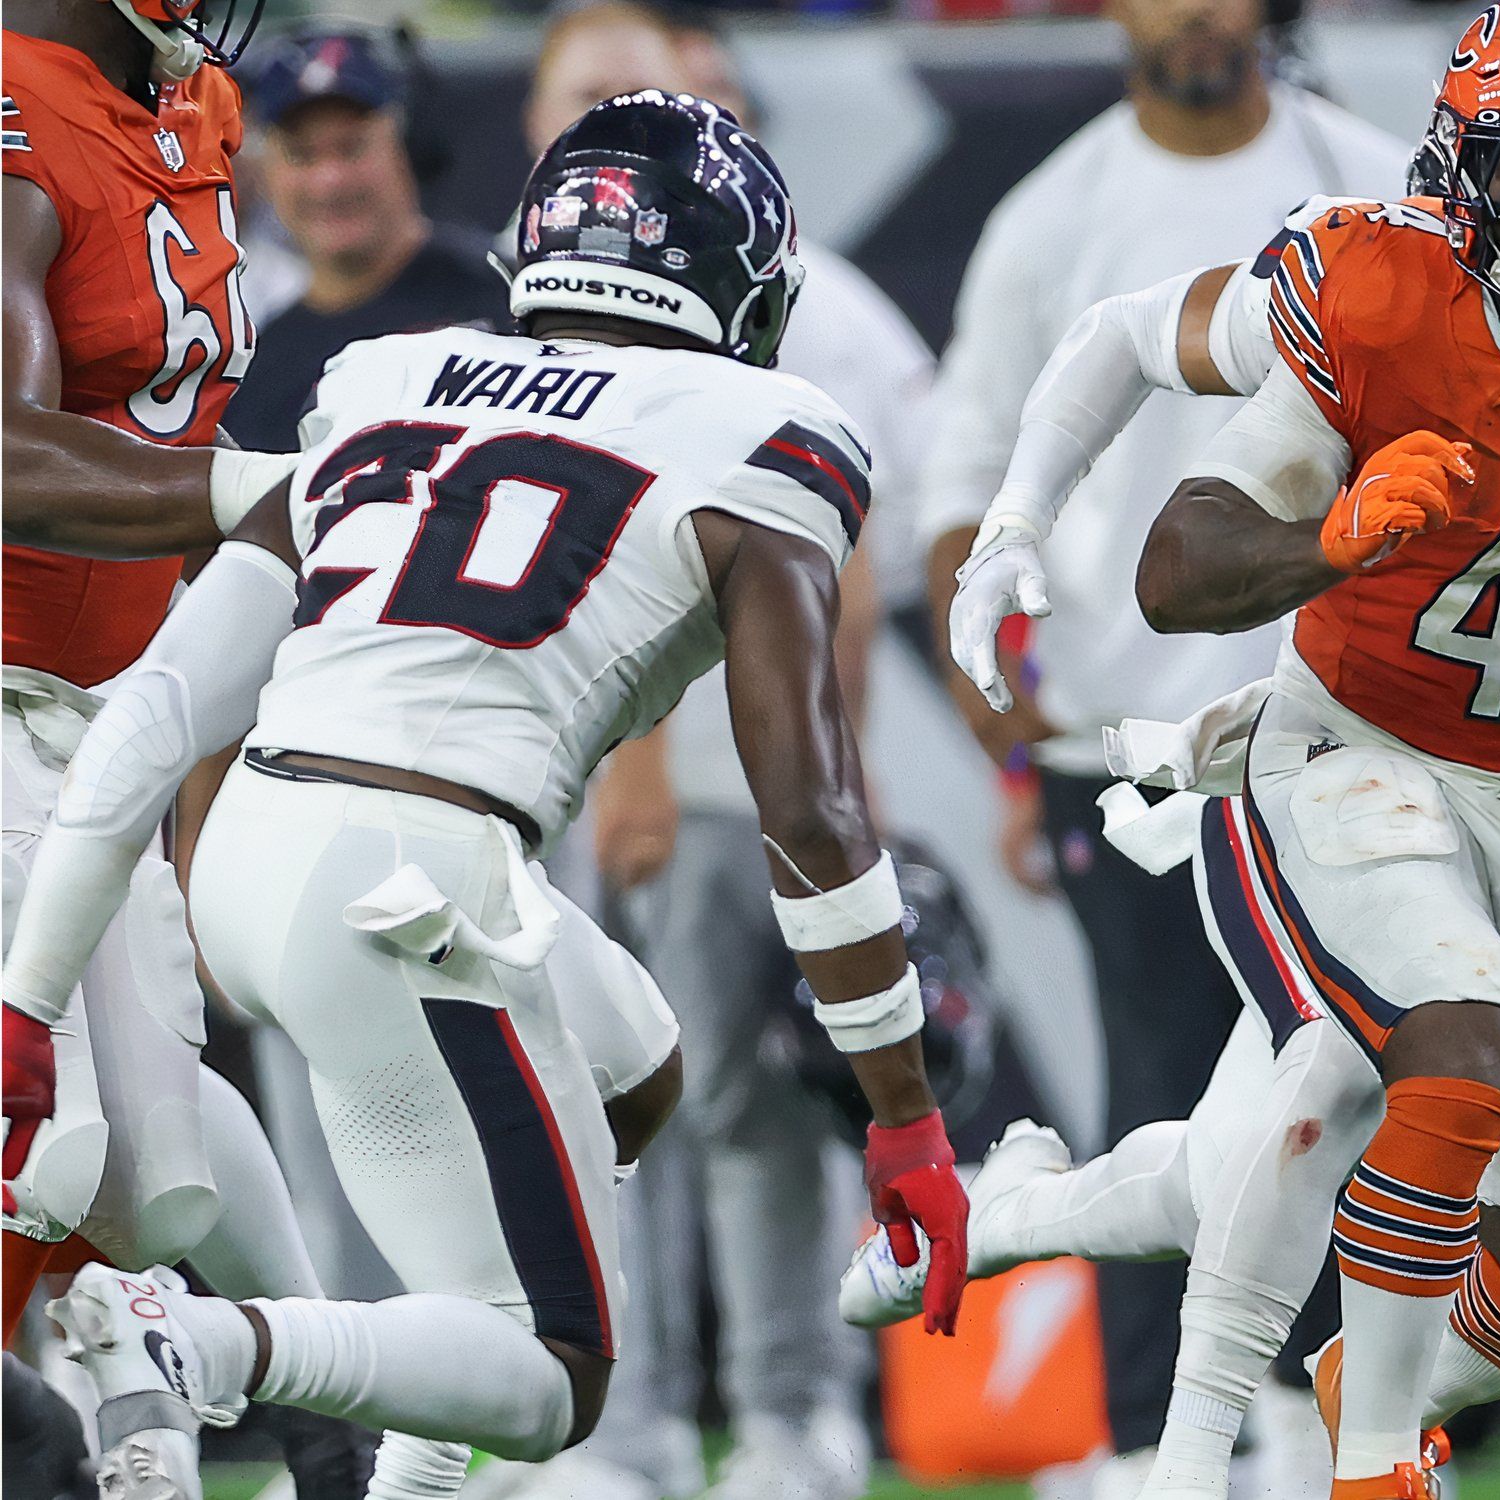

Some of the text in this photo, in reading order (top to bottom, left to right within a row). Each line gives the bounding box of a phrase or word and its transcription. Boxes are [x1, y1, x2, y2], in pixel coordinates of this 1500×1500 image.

[525, 278, 682, 314] HOUSTON
[423, 354, 616, 421] WARD
[293, 419, 659, 650] 20
[115, 1278, 166, 1319] 20
